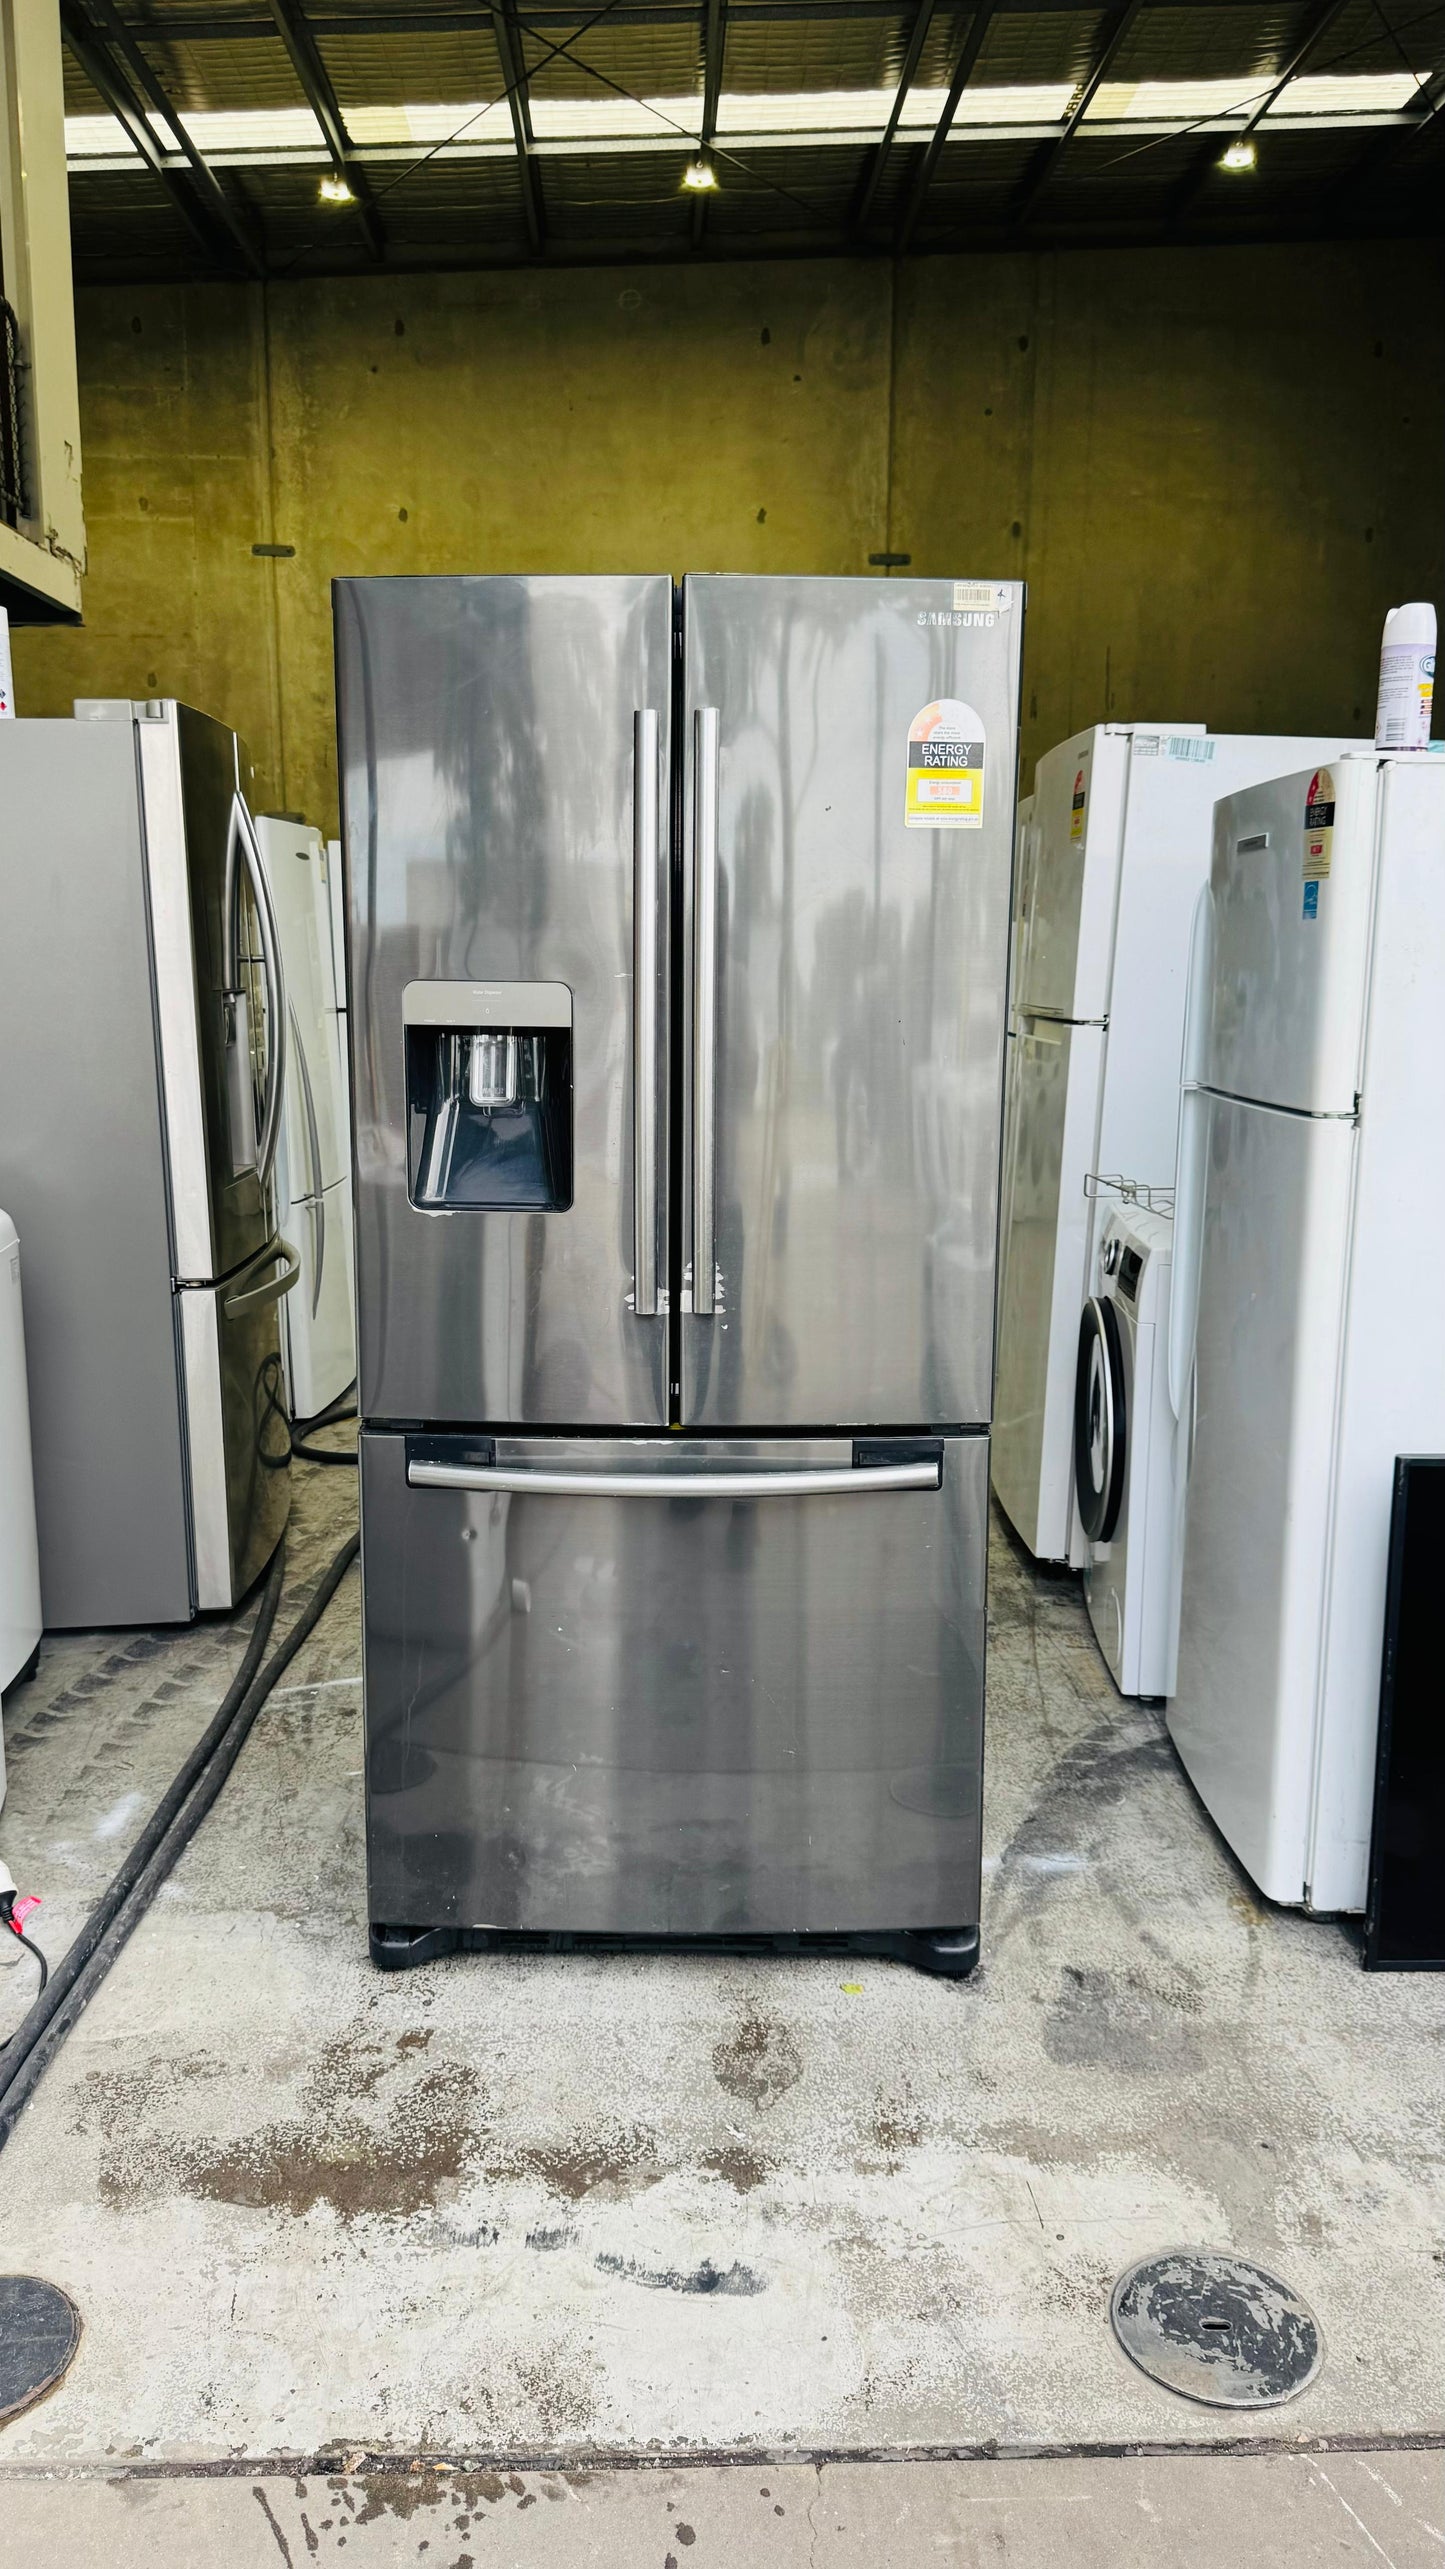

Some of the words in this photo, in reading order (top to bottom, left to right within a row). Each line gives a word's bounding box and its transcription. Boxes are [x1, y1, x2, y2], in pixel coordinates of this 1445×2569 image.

[917, 611, 995, 627] SAMSUNG
[922, 744, 972, 755] ENERGY
[924, 756, 968, 767] RATING
